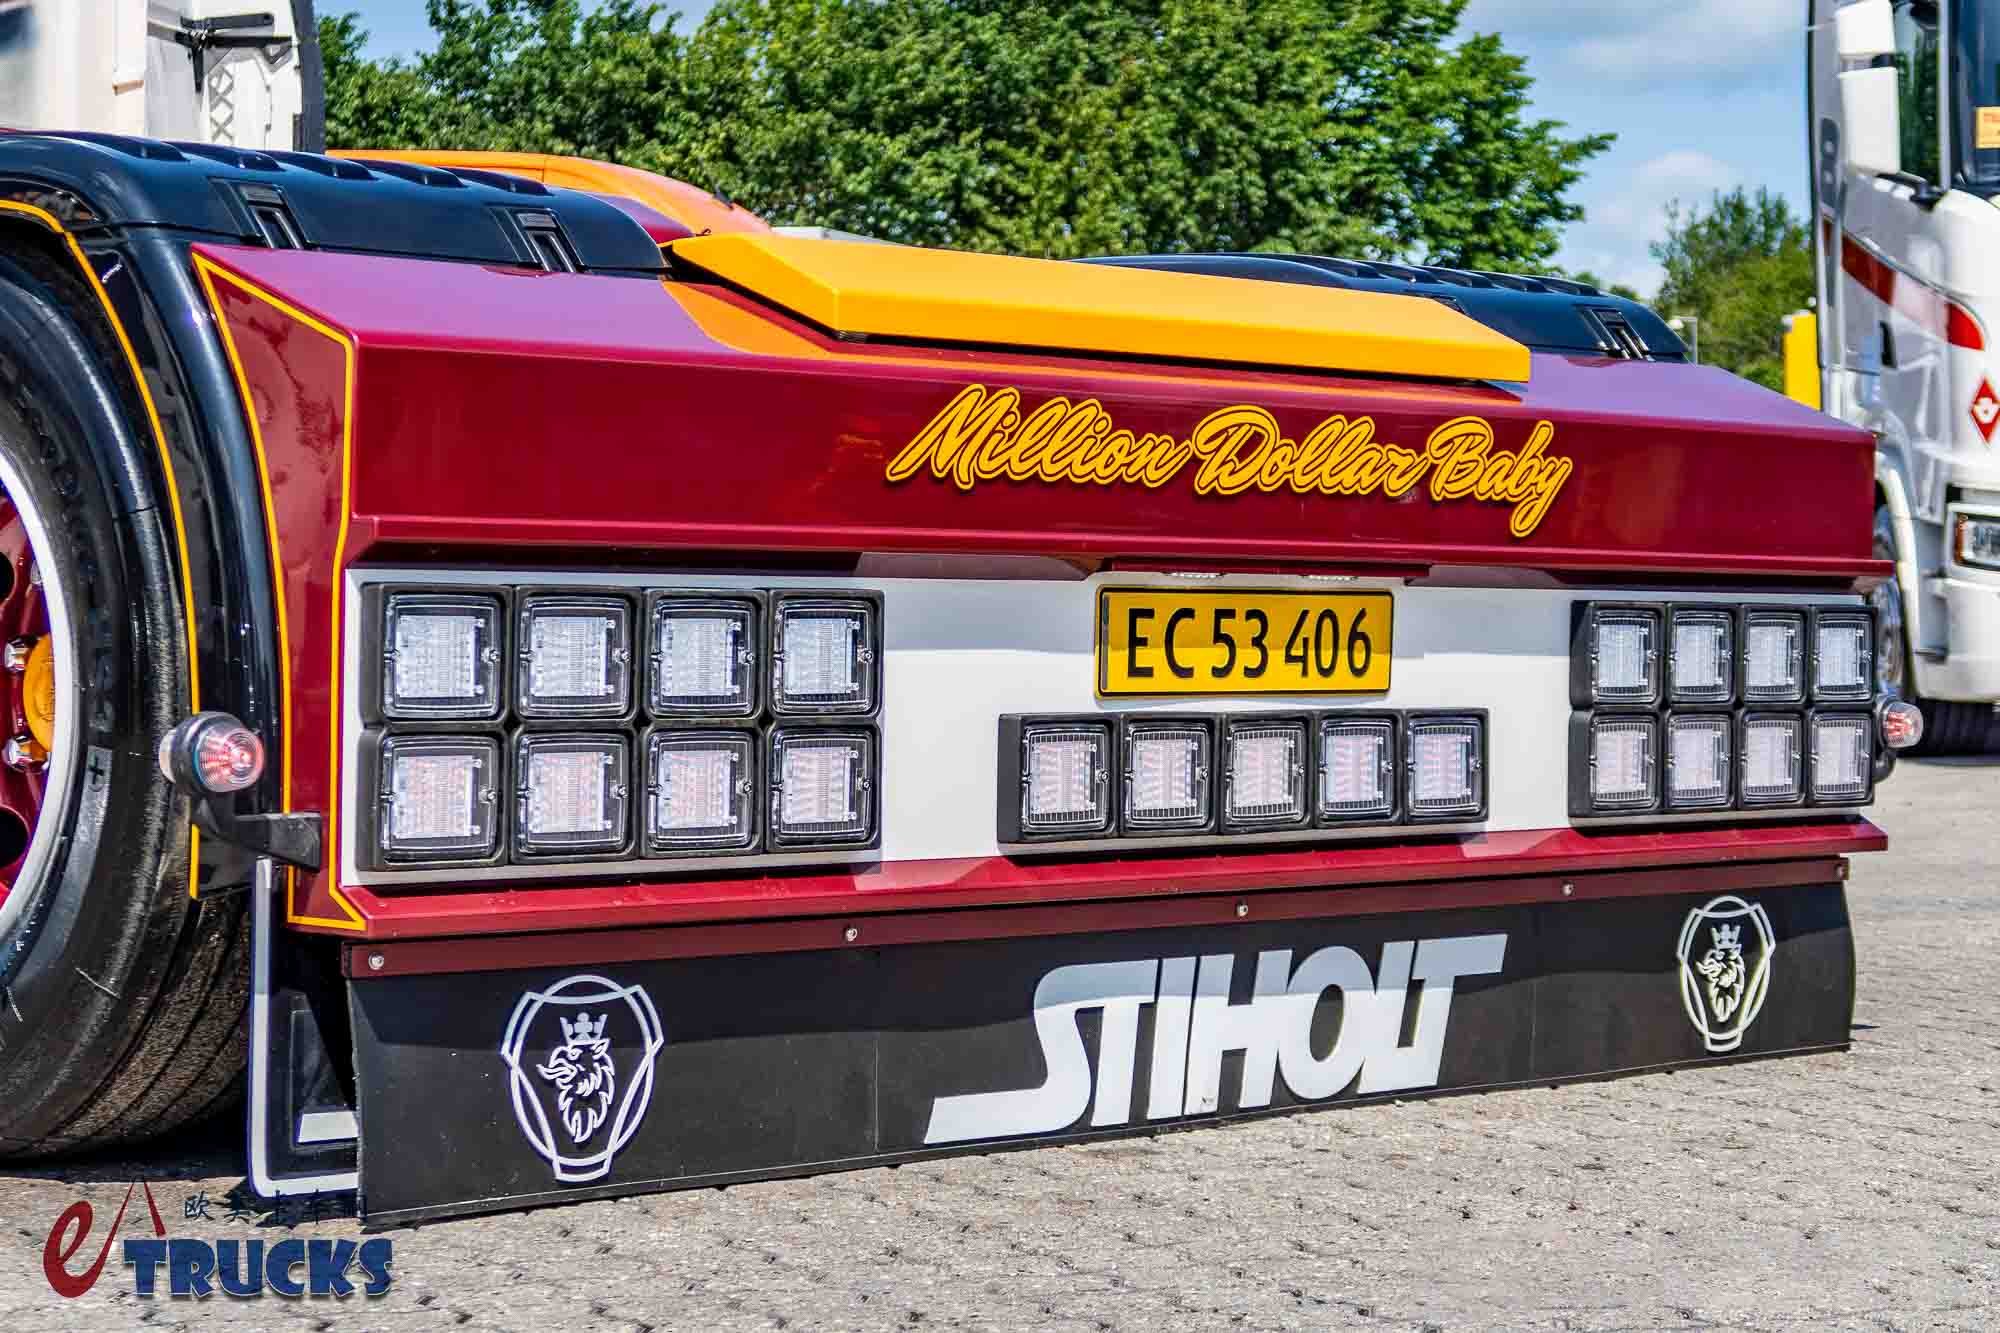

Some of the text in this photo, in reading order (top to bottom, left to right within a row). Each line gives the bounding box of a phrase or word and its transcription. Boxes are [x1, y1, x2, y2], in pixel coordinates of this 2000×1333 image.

[886, 384, 1572, 537] Million Dollar Baby
[1127, 607, 1195, 678] EC
[1284, 607, 1371, 678] 406
[924, 934, 1508, 1145] STIHOLT
